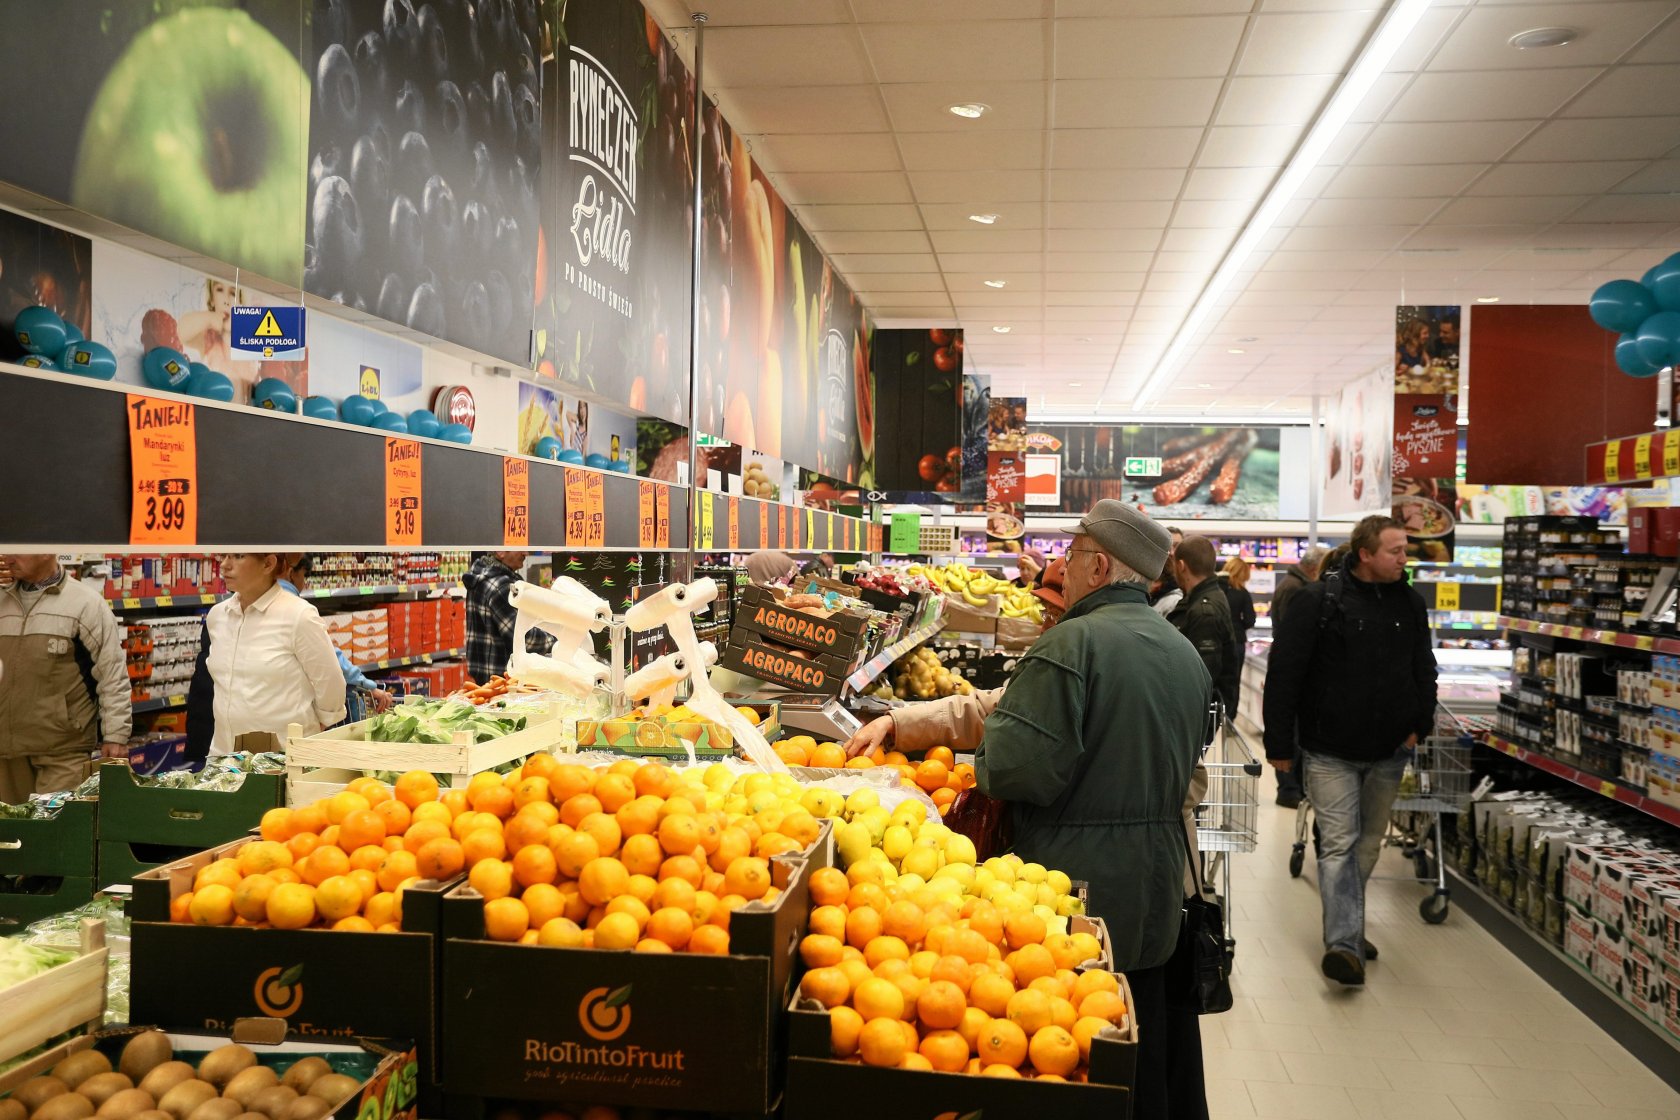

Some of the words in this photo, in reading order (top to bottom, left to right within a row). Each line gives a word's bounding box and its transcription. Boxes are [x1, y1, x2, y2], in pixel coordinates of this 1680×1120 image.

[569, 58, 638, 204] RYNECZEK
[570, 174, 632, 275] Lidla
[565, 262, 575, 284] PO
[578, 271, 606, 303] PROSTU
[234, 307, 262, 315] UWAGA!
[239, 336, 264, 346] ŚLISKA
[265, 338, 297, 346] PODŁOGA
[131, 399, 190, 430] TANIEJ!
[143, 437, 185, 453] Mandarynki
[388, 440, 420, 462] TANIEJ!
[1406, 437, 1444, 456] PYSZNE
[505, 458, 527, 477] TANIEJ!
[145, 496, 185, 531] 3.99
[395, 510, 415, 536] 3.19
[508, 517, 527, 538] 14.39
[569, 521, 584, 539] 4.39
[589, 523, 601, 540] 2.79
[754, 607, 837, 647] AGROPACO
[742, 648, 825, 688] AGROPACO
[524, 1039, 685, 1070] RioTintoFruit
